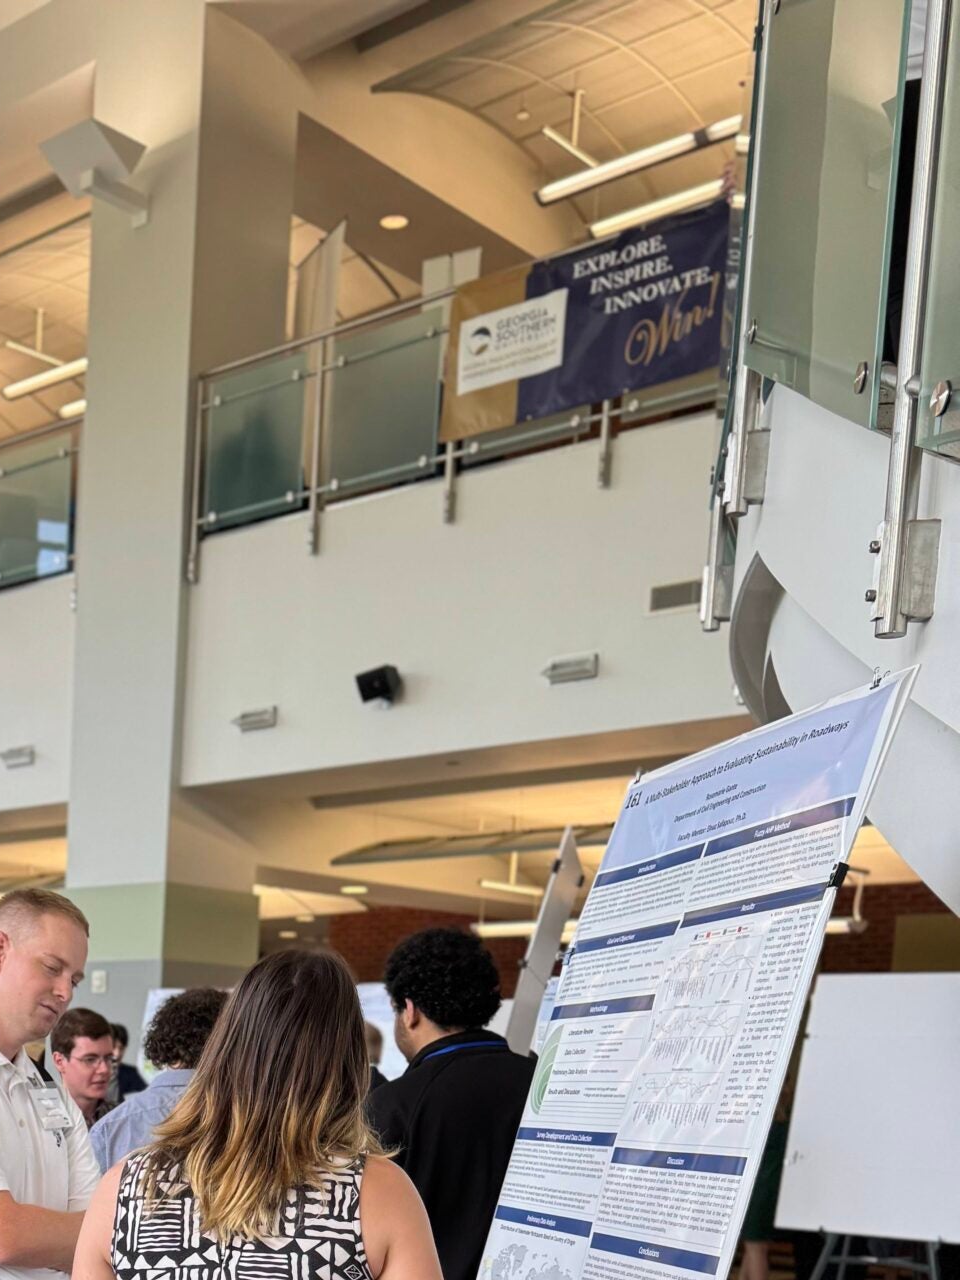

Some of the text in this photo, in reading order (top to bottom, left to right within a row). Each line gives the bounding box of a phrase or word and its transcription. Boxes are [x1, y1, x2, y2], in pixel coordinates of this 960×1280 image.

[572, 234, 667, 279] EXPLORE.
[589, 255, 673, 295] INSPIRE.
[604, 266, 713, 315] INNOVATE.
[496, 308, 548, 330] GEORGIA
[496, 314, 557, 342] SOUTHERN
[624, 271, 721, 367] Win!
[645, 721, 849, 804] A Multi-Stakeholder Approach to Evaluating Sustainability in Roadways
[625, 791, 642, 809] 161
[674, 810, 696, 823] Department
[709, 797, 731, 810] Engineering
[731, 792, 740, 801] and
[740, 784, 766, 798] Construction
[677, 833, 690, 841] Faculty
[773, 818, 792, 832] Method
[639, 1247, 659, 1258] Conclusions
